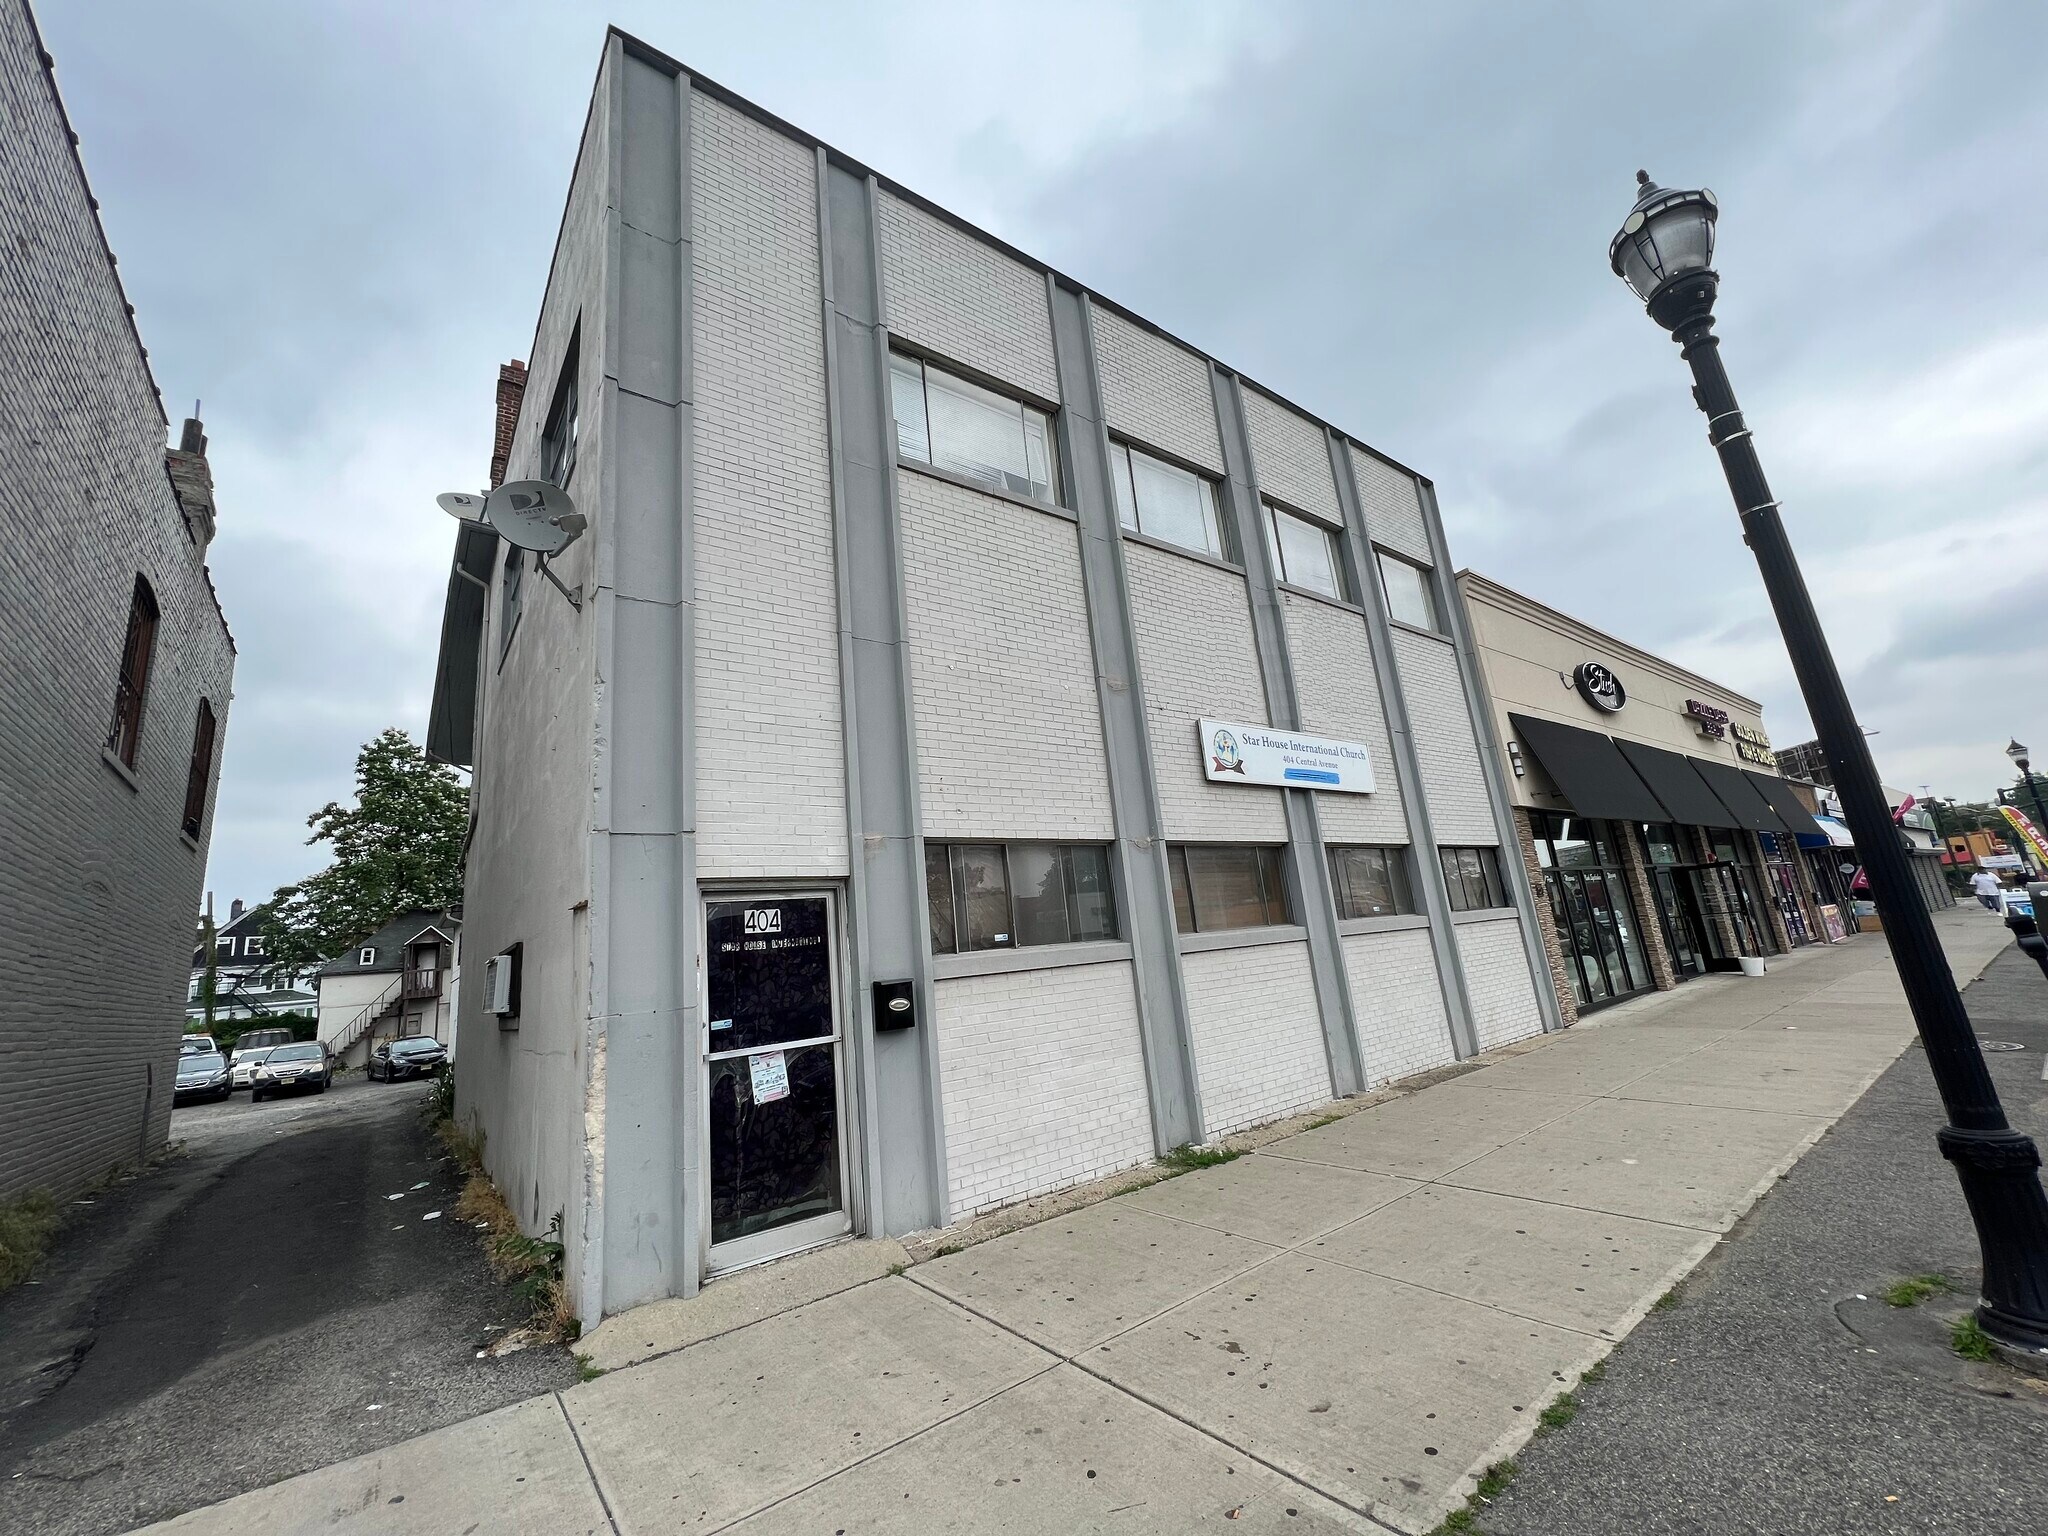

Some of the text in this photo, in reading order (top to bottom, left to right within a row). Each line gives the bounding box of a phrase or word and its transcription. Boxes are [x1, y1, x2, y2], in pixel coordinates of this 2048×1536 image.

[515, 506, 547, 516] DIRECTV
[1242, 733, 1367, 760] Star House International Church
[1283, 755, 1339, 769] 404 Central Avenue
[745, 910, 781, 931] 404
